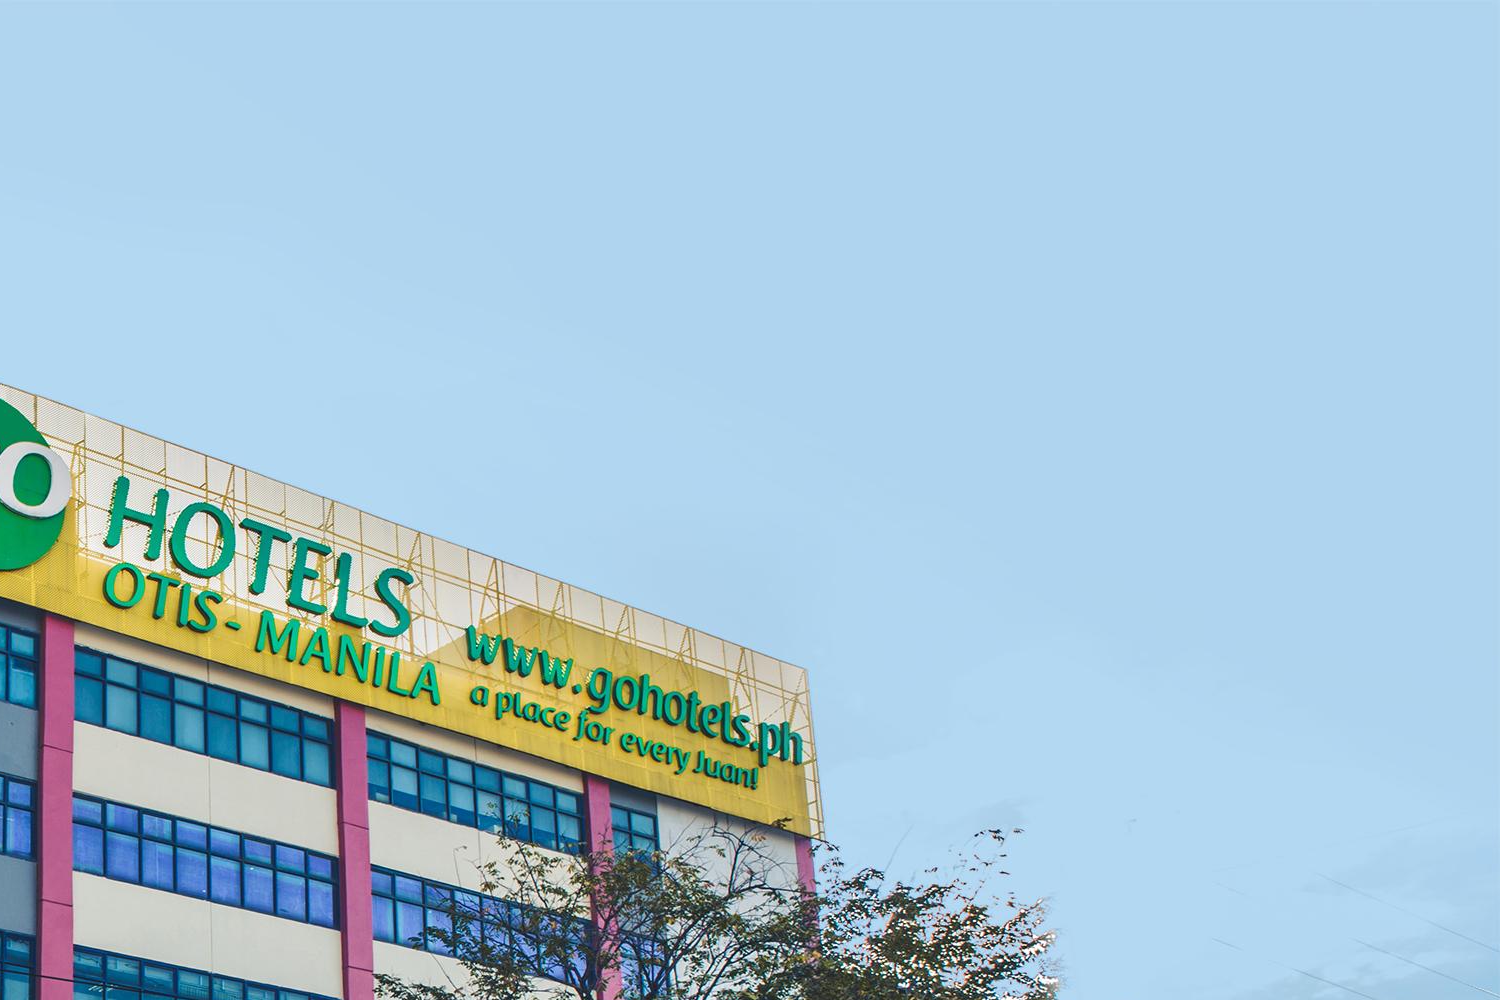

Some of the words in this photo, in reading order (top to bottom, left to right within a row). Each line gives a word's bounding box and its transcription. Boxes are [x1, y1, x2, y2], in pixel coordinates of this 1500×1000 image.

[103, 475, 414, 637] HOTELS
[102, 562, 223, 632] OTIS
[255, 610, 441, 705] MANILA
[466, 624, 803, 767] www.gohotels.ph
[469, 685, 489, 706] a
[496, 690, 571, 731] place
[574, 706, 615, 744] for
[620, 729, 691, 775] every
[695, 751, 759, 790] Juan!
